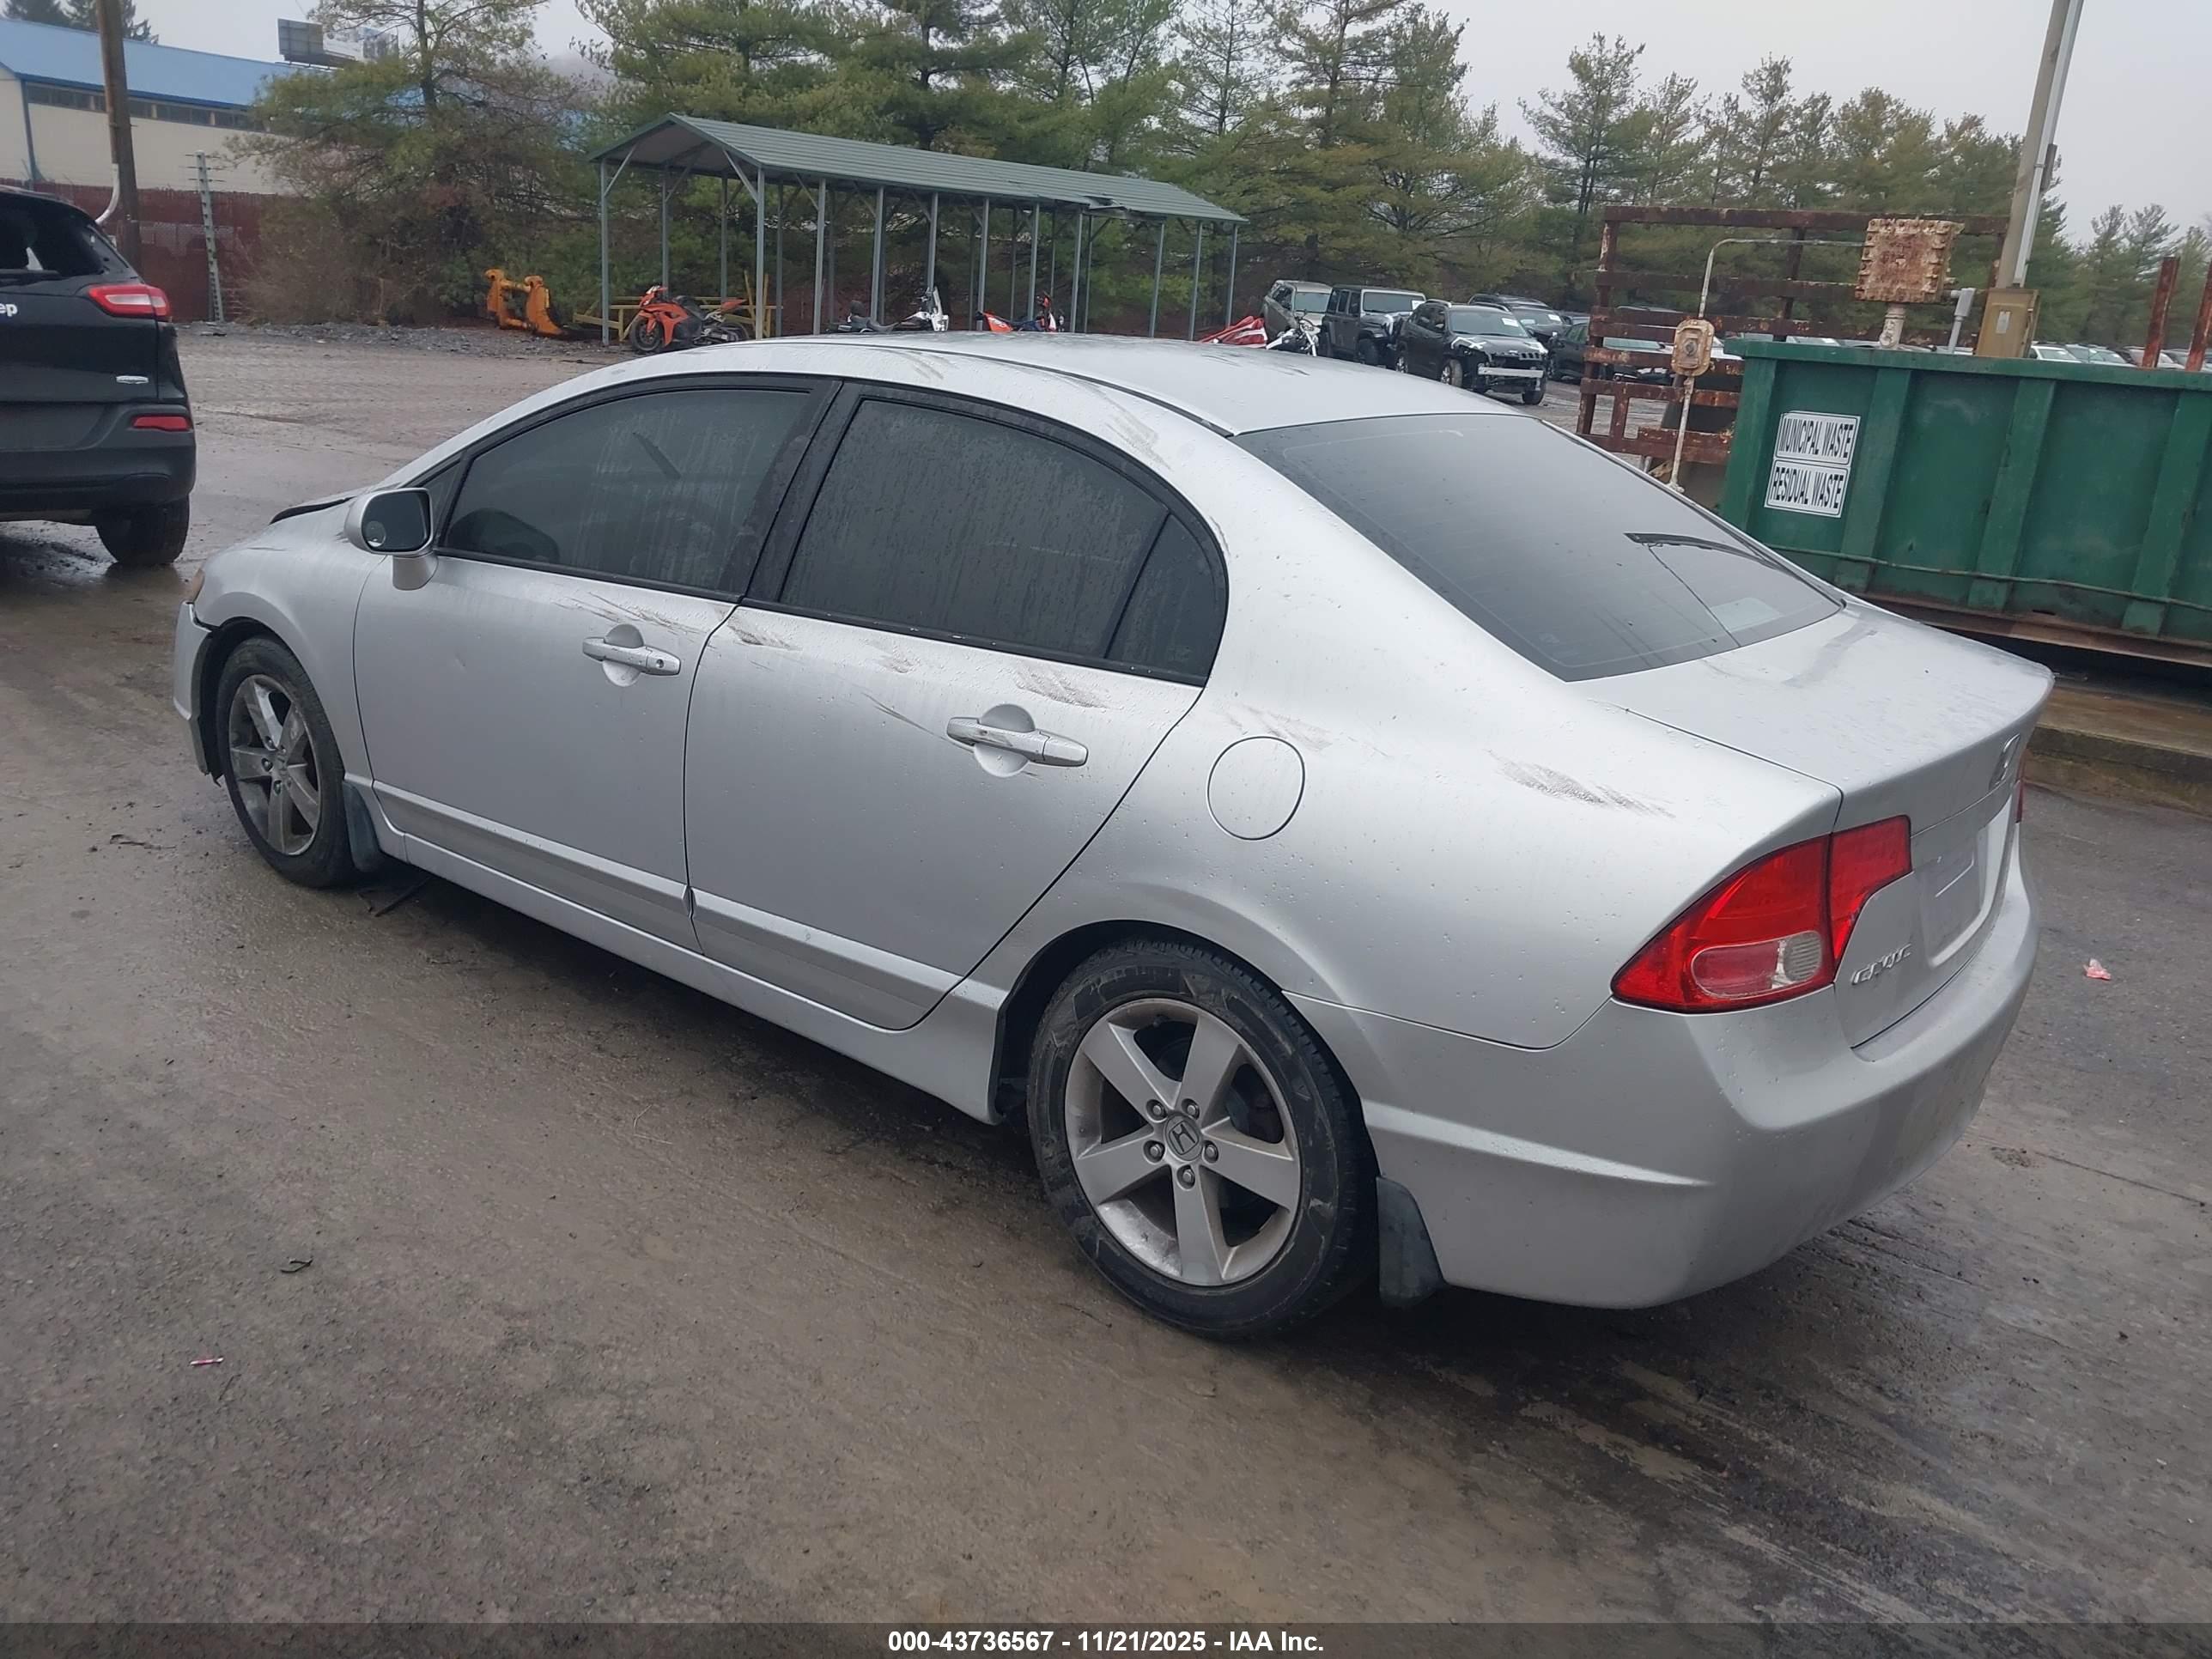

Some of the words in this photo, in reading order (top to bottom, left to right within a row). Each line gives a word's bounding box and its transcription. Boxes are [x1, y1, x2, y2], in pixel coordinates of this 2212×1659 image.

[1778, 418, 1822, 455] MUNICIPAL
[1821, 422, 1854, 459] WASTE
[1770, 466, 1811, 505] RESIDUAL
[1811, 471, 1844, 509] WASTE
